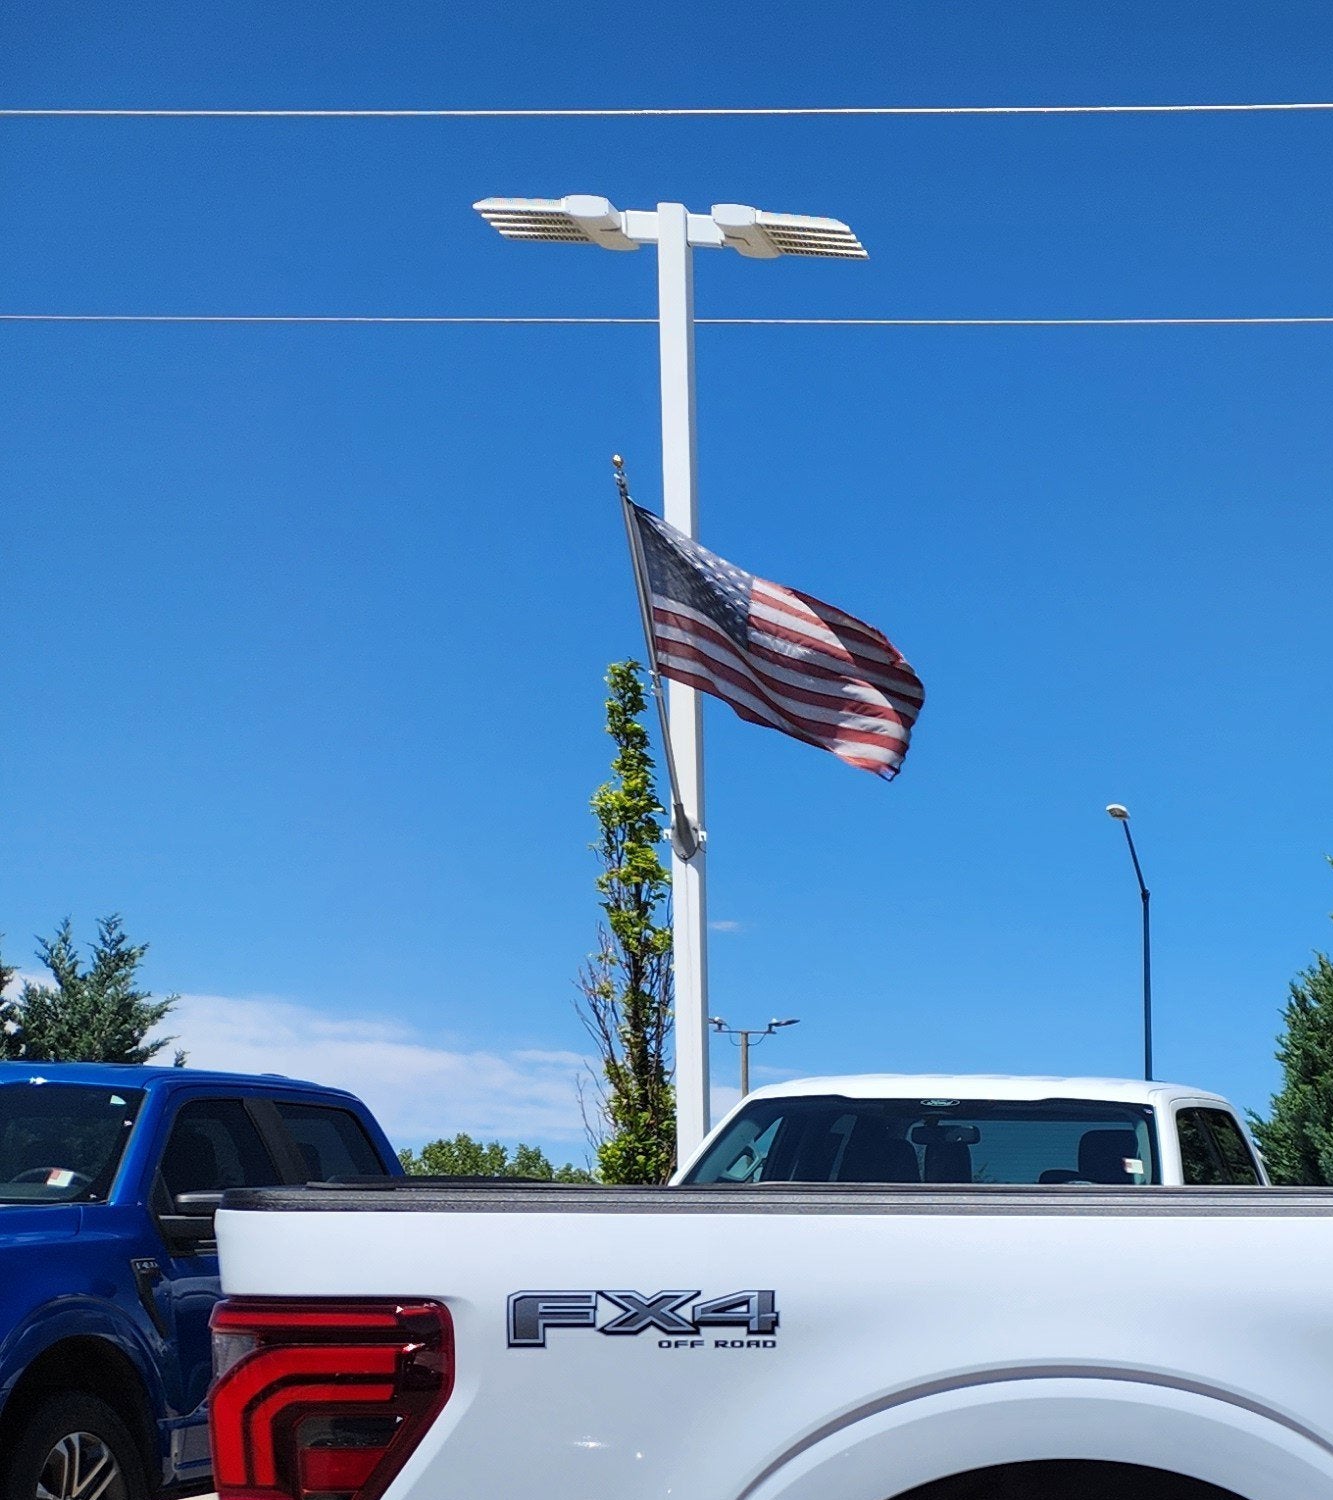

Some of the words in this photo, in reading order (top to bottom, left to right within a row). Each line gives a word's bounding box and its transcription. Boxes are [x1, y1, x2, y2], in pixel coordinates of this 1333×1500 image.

[507, 1290, 779, 1349] FX4
[658, 1340, 704, 1349] OFF
[714, 1340, 777, 1349] ROAD
